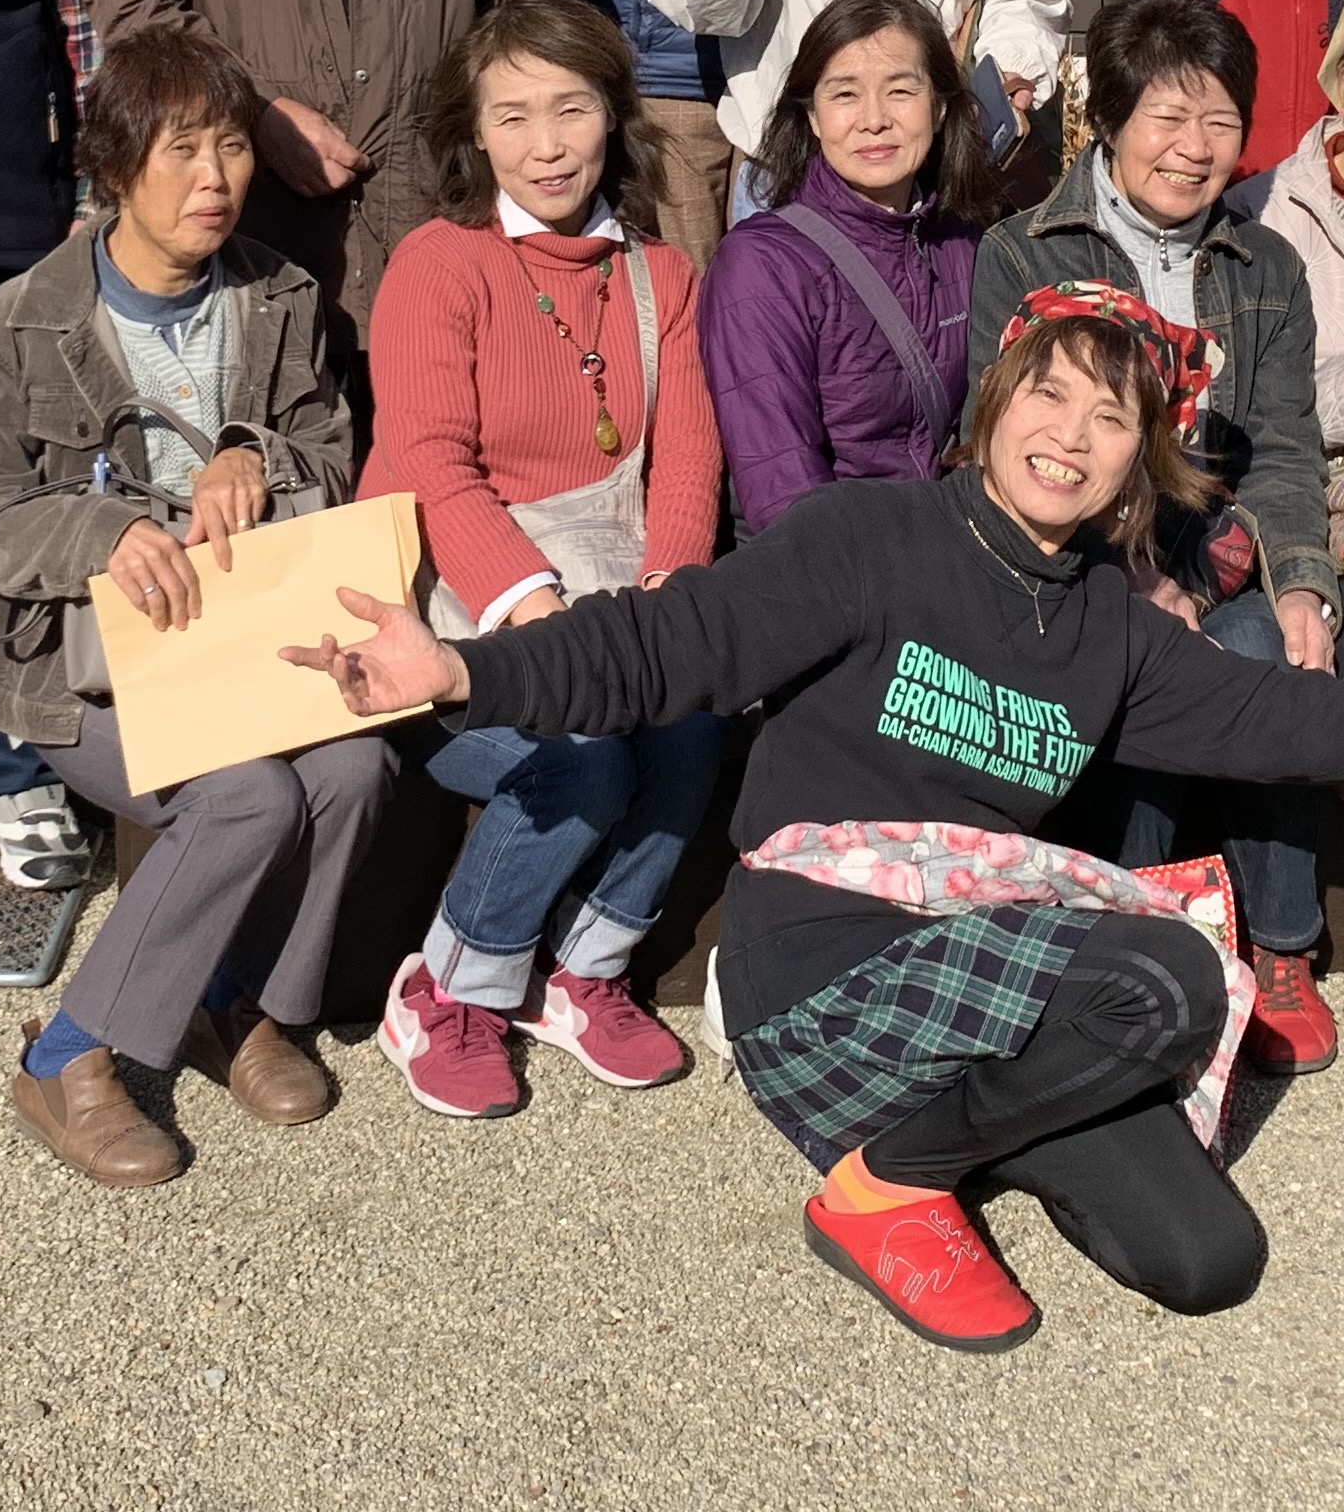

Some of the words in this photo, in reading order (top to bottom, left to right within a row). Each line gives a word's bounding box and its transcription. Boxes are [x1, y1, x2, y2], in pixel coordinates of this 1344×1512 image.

[884, 677, 996, 748] GROWING
[999, 720, 1040, 764] THE
[897, 641, 992, 711] GROWING
[995, 684, 1077, 738] FRUITS.
[877, 713, 955, 757] DAI-CHAN
[950, 739, 987, 770] FARM
[986, 754, 1023, 783] ASAHI
[1022, 766, 1056, 796] TOWN,
